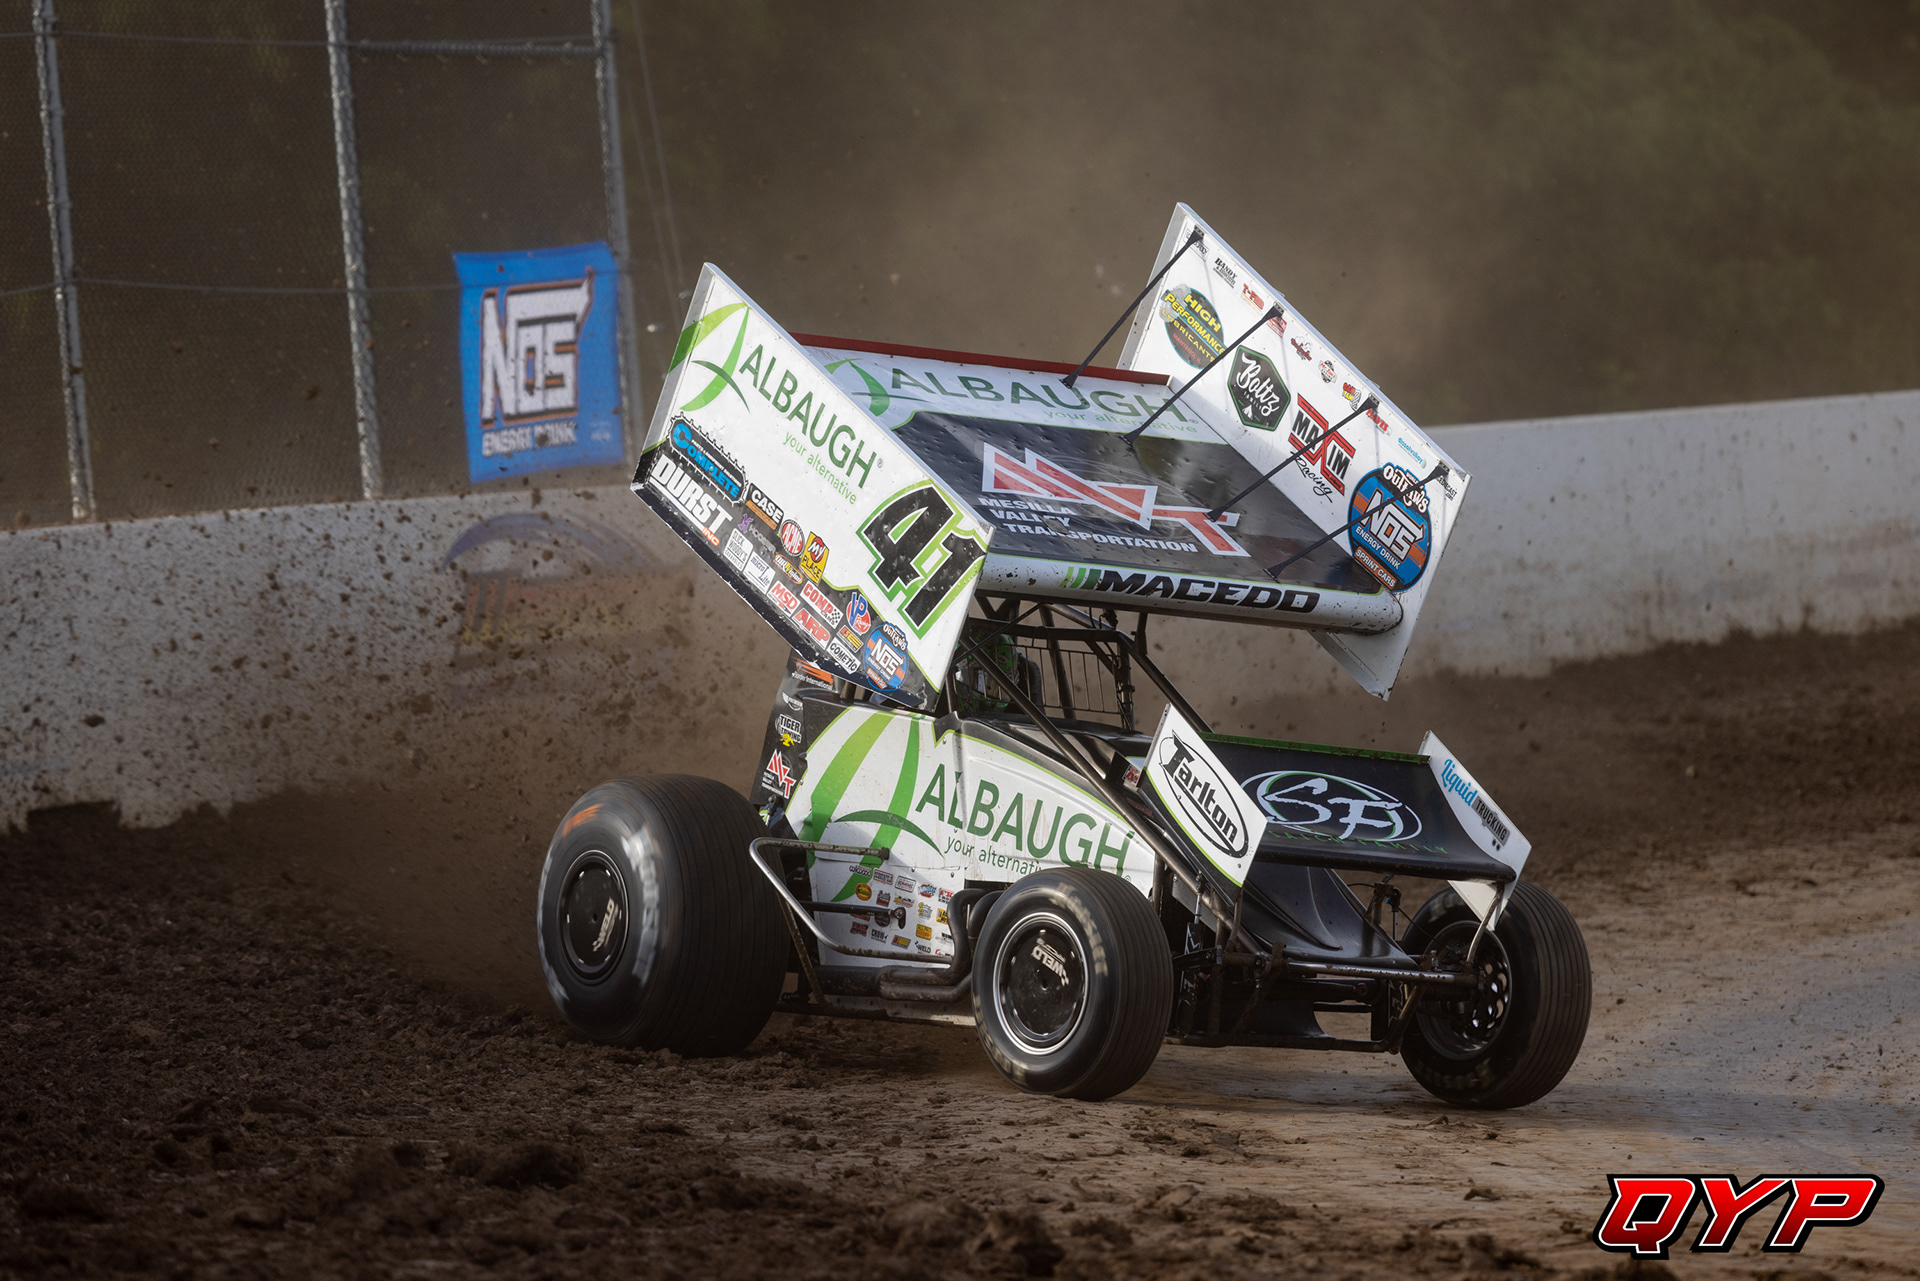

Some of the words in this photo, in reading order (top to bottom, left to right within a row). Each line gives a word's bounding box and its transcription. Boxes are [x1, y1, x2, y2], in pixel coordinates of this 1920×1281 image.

[1164, 292, 1226, 355] PERFORMANCE
[1184, 294, 1222, 332] HIGH
[480, 266, 595, 428] NOS
[1162, 309, 1216, 363] LUBRICANTS
[891, 368, 1189, 422] ALBAUGH
[1236, 352, 1280, 416] Boltz
[739, 344, 877, 489] ALBAUGH
[1044, 409, 1087, 421] your
[1366, 408, 1388, 432] DAVIS
[673, 424, 740, 498] COMPLETE
[1290, 402, 1352, 486] MAXIM
[784, 431, 806, 455] your
[807, 455, 857, 504] alternative
[1290, 451, 1333, 503] Racing
[651, 454, 733, 534] DURST
[752, 490, 782, 523] CASE
[978, 498, 1078, 516] MESILLA
[702, 526, 720, 546] INC
[782, 522, 803, 554] ACME
[1360, 488, 1425, 562] NOS
[802, 555, 822, 578] PLACE
[808, 542, 826, 560] MY
[860, 483, 988, 632] 41
[1356, 527, 1380, 552] ENERGY
[1380, 548, 1401, 570] DRINK
[1355, 550, 1379, 572] SPRINT
[1377, 568, 1396, 588] CARS
[772, 583, 798, 610] MSD
[803, 584, 834, 614] COMP
[850, 592, 868, 626] VP
[1100, 570, 1321, 614] MACEDO
[795, 608, 830, 642] ARP
[830, 642, 858, 671] COMETIC
[870, 640, 904, 676] NOS
[780, 716, 800, 732] TIGER
[1162, 730, 1238, 845] Tarlton
[1441, 758, 1478, 806] Liquid
[915, 763, 1134, 878] ALBAUGH
[1476, 800, 1507, 840] TRUCKING
[944, 835, 973, 858] your
[978, 850, 1040, 875] alternati
[918, 945, 932, 954] WELD
